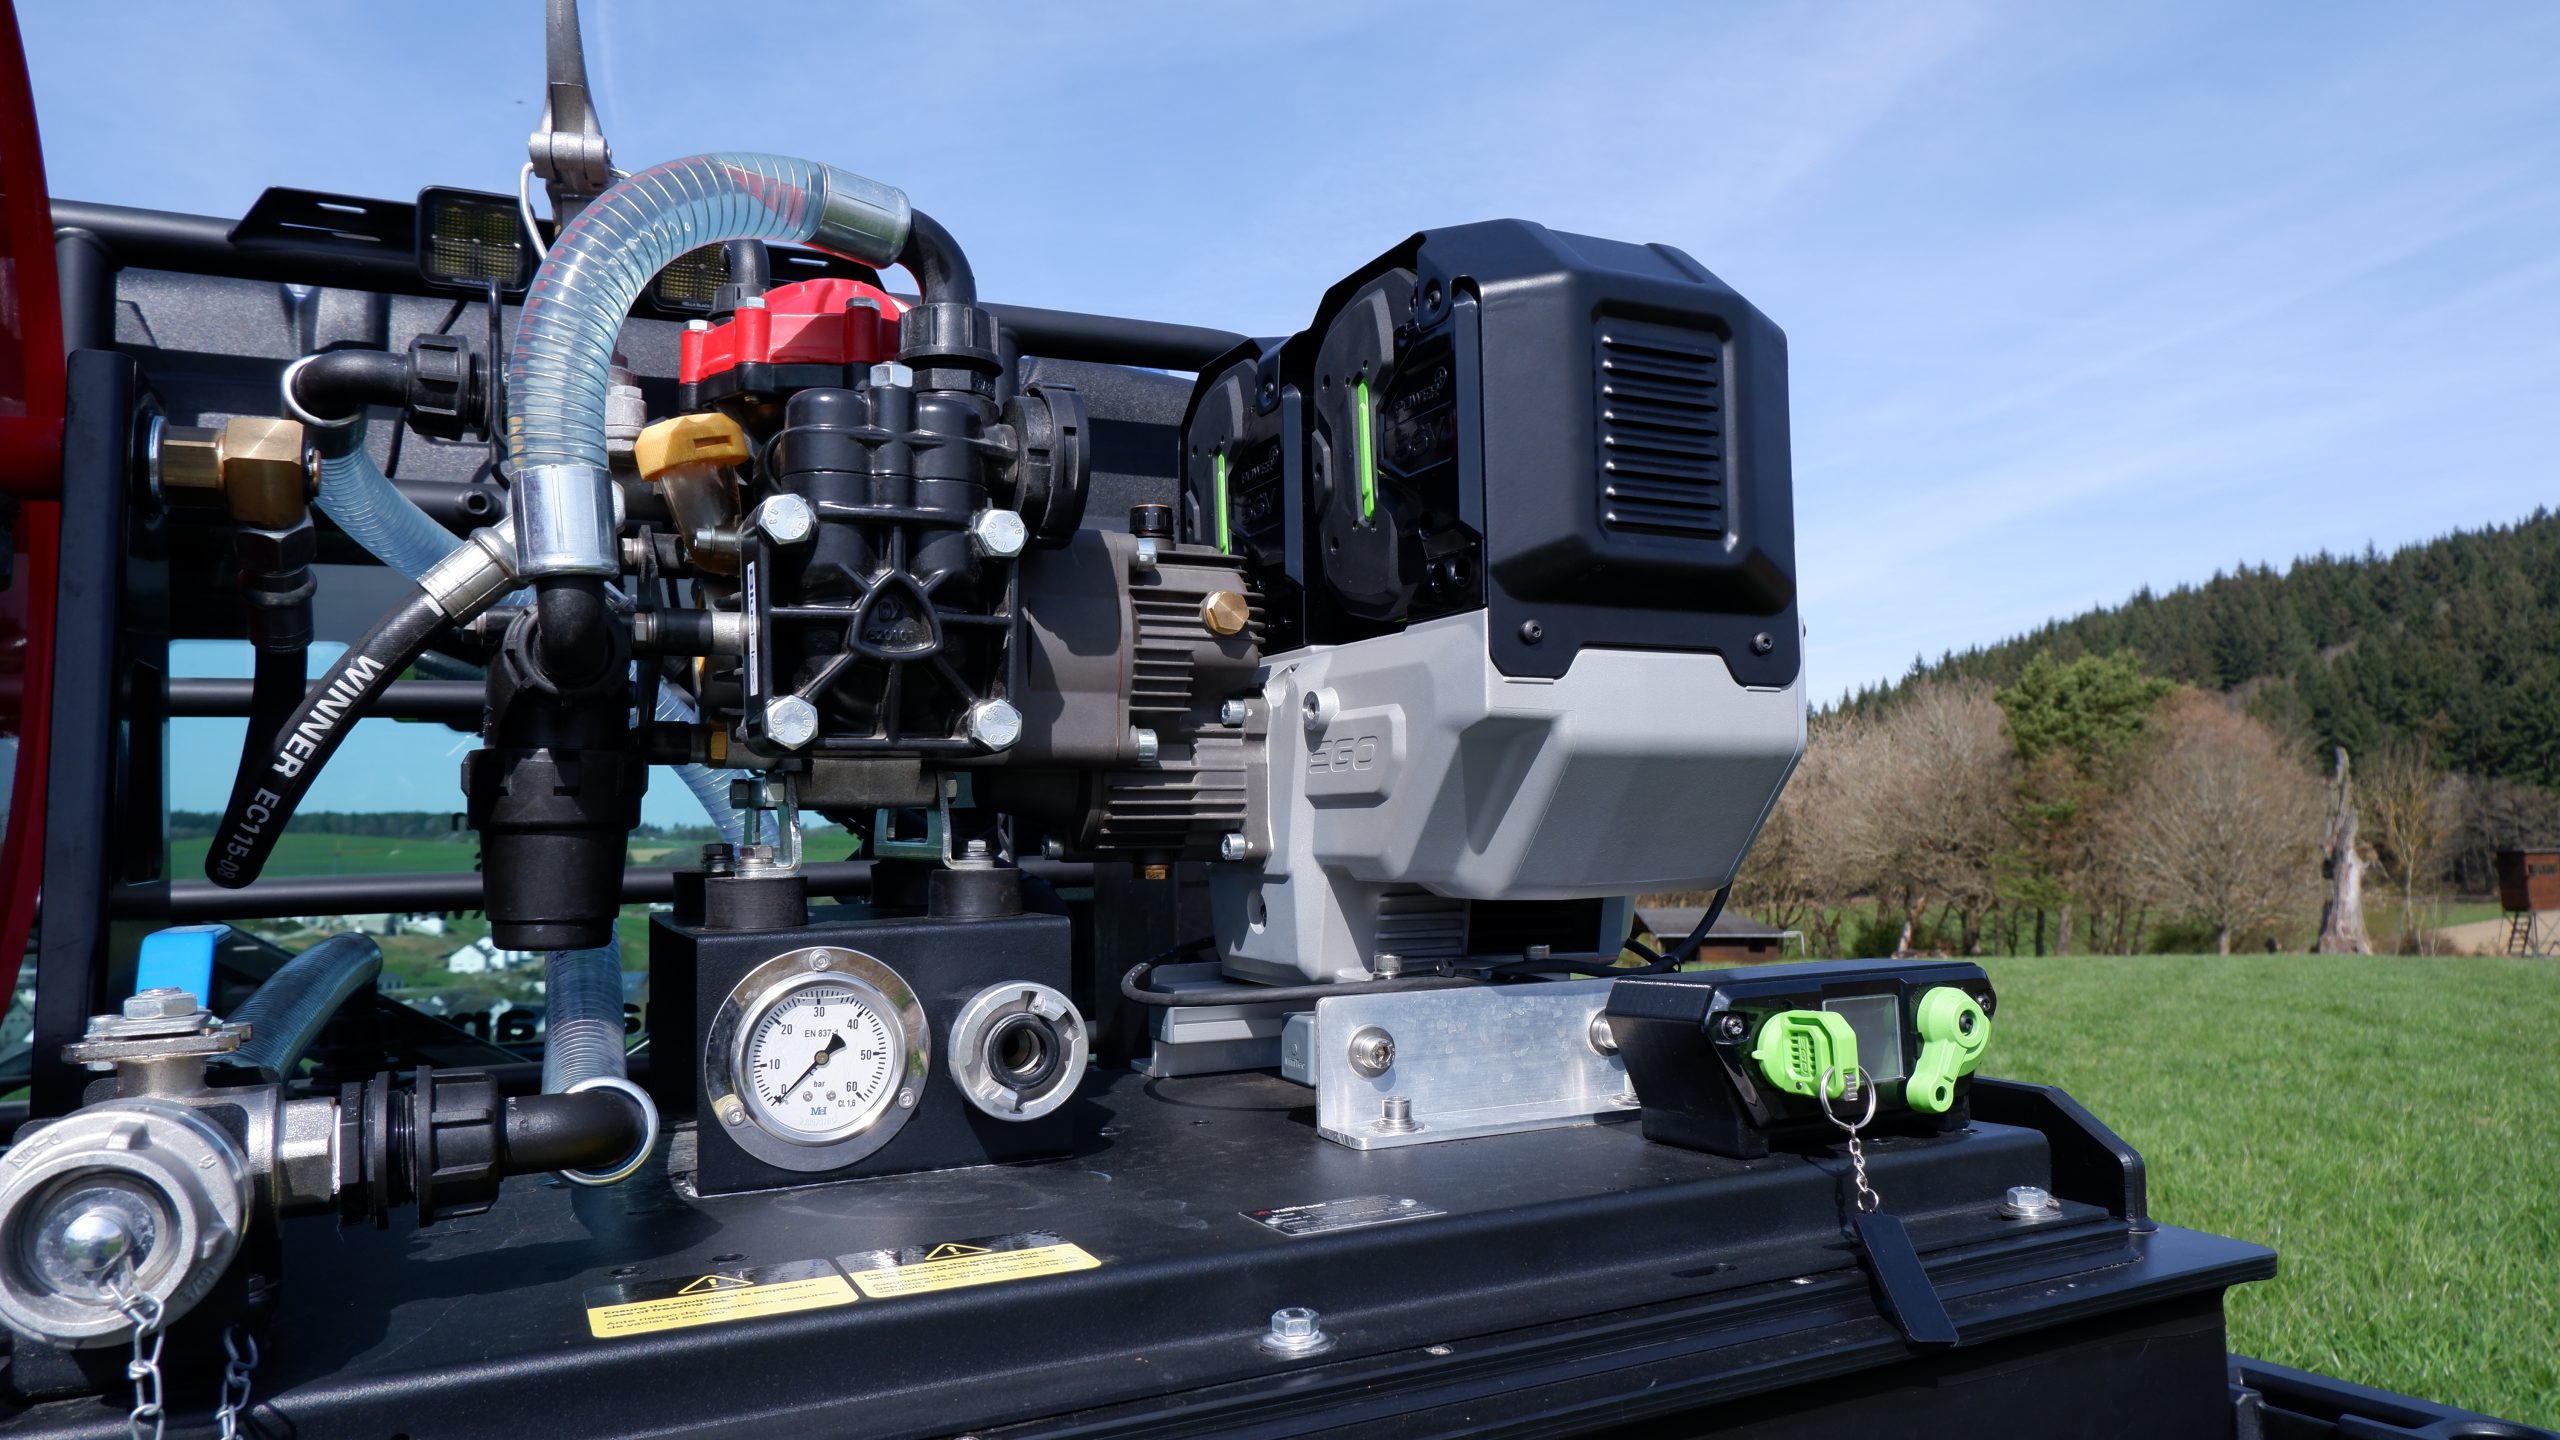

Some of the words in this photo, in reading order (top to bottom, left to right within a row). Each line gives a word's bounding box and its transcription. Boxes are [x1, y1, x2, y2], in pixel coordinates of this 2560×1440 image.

[271, 655, 385, 778] WINNER
[813, 1006, 825, 1017] 30
[847, 1018, 859, 1029] 40
[781, 1024, 793, 1035] 20
[804, 1029, 816, 1038] EN
[860, 1049, 872, 1060] 50
[769, 1059, 780, 1070] 10
[781, 1083, 787, 1095] 0
[813, 1080, 826, 1088] bar
[846, 1081, 858, 1092] 60
